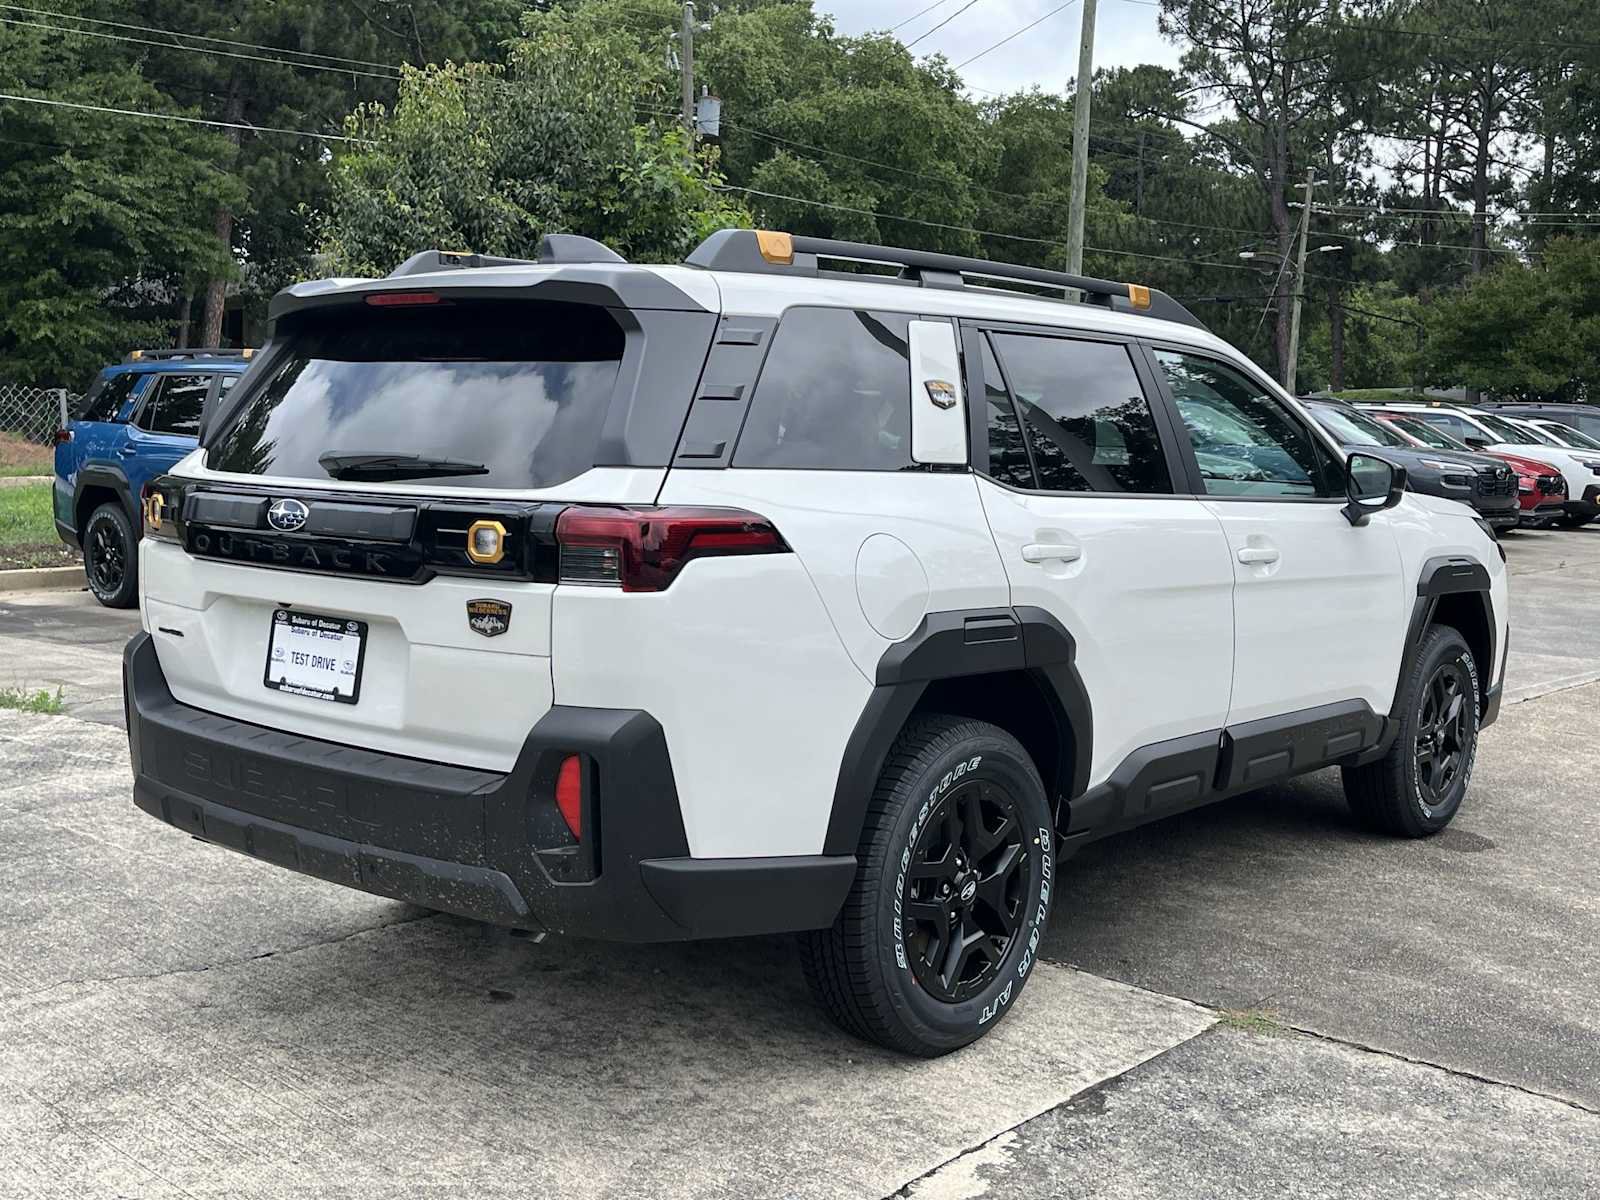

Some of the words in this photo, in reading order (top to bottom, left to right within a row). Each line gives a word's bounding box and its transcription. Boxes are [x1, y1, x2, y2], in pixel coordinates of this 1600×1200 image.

[194, 532, 387, 573] OUTBACK
[290, 626, 310, 636] Subaru
[319, 631, 344, 641] Decatur
[291, 615, 311, 626] Subaru
[311, 619, 318, 627] of
[318, 620, 341, 630] Decatur
[291, 651, 310, 667] TEST
[311, 655, 337, 671] DRIVE
[893, 755, 983, 970] BRIDGESTONE
[1017, 827, 1052, 978] DUELER
[979, 979, 1013, 1025] A/T
